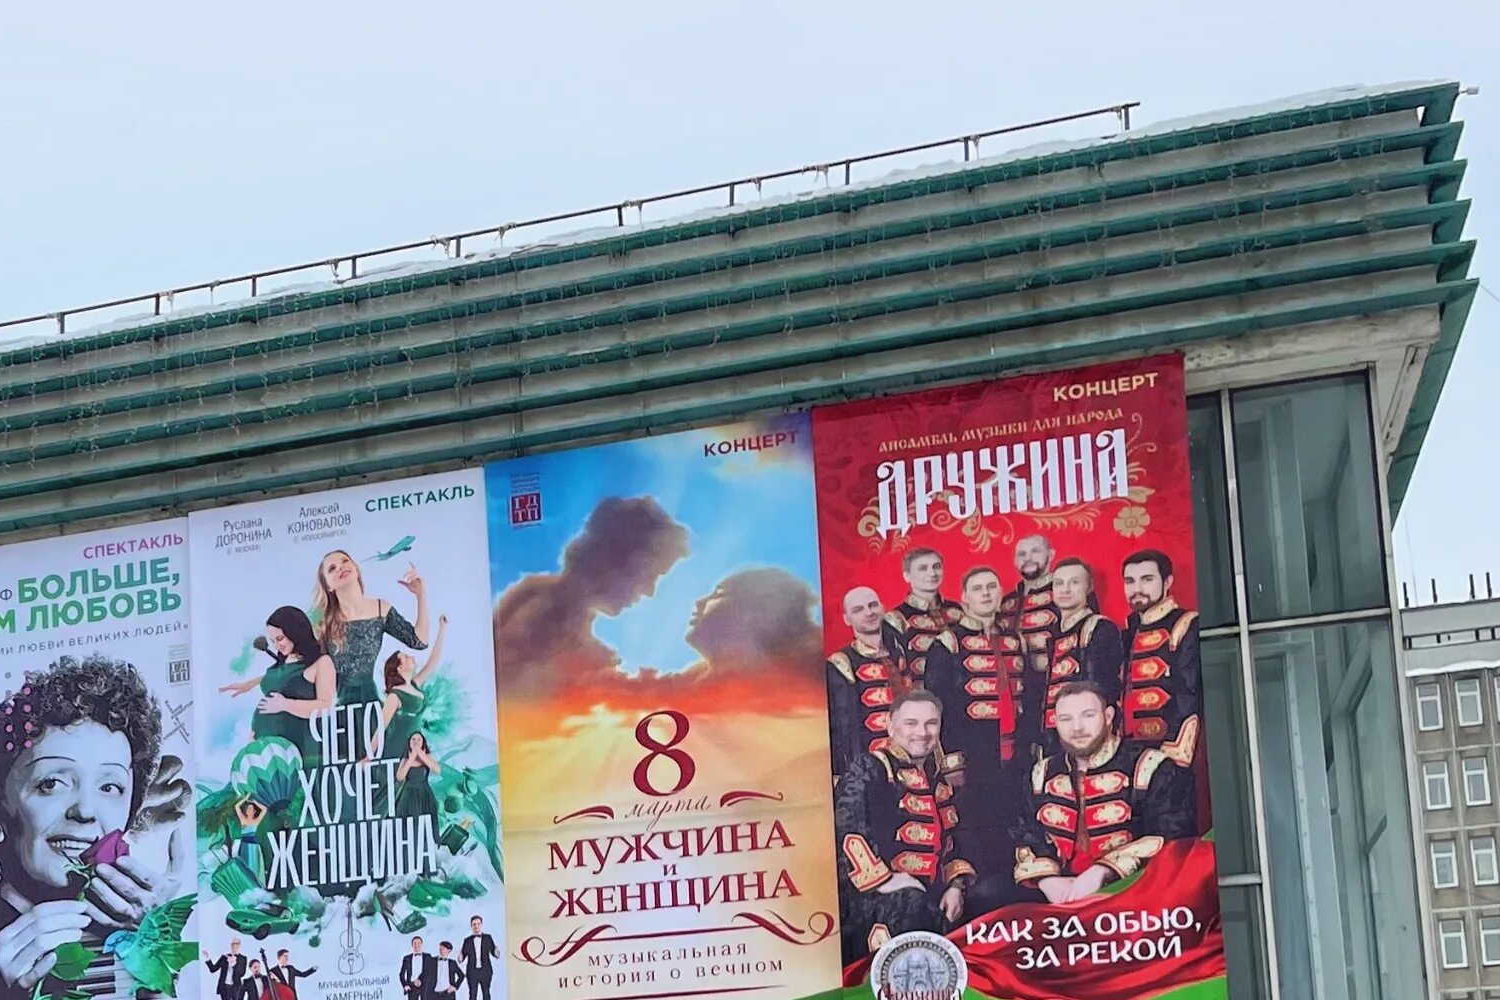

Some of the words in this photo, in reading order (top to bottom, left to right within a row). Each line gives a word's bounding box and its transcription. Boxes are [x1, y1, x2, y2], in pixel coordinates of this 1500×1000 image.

[1053, 372, 1158, 402] КОНЦЕРТ
[704, 430, 799, 457] КОНЦЕРТ
[879, 433, 958, 453] АНСАМБЛЬ
[962, 422, 1028, 442] МУЗЫКИ
[1032, 416, 1061, 433] ДЛЯ
[1066, 407, 1124, 426] НАРОДА
[365, 485, 475, 513] СПЕКТАКЛЬ
[876, 428, 1130, 540] ДРУЖИНА
[224, 518, 262, 531] Руслана
[288, 514, 351, 534] КОНОВАЛОВ
[300, 503, 340, 518] Алексей
[83, 533, 184, 559] СПЕКТАКЛЬ
[216, 528, 272, 548] ДОРОНИНА
[18, 557, 180, 604] БОЛЬШЕ,
[26, 586, 182, 632] ЛЮБОВЬ
[18, 639, 65, 654] ЛЮБВИ
[69, 631, 129, 648] ВЕЛИКИХ
[309, 700, 386, 766] ЧЕГО
[633, 710, 696, 797] 8
[298, 757, 400, 827] ХОЧЕТ
[625, 795, 712, 831] марта
[267, 814, 437, 889] ЖЕНЩИНА
[547, 819, 796, 874] МУЖЧИНА
[549, 868, 802, 918] ЖЕНЩИНА
[966, 918, 1033, 947] КАК
[1041, 915, 1088, 940] ЗА
[1093, 906, 1202, 936] ОБЬЮ,
[588, 943, 747, 968] музыкальная
[1016, 946, 1062, 970] ЗА
[1068, 930, 1182, 965] РЕКОЙ
[318, 975, 391, 990] МУНИЦИПАЛЬНЫЙ
[559, 969, 656, 989] история
[670, 967, 681, 980] о
[697, 958, 783, 978] вечном
